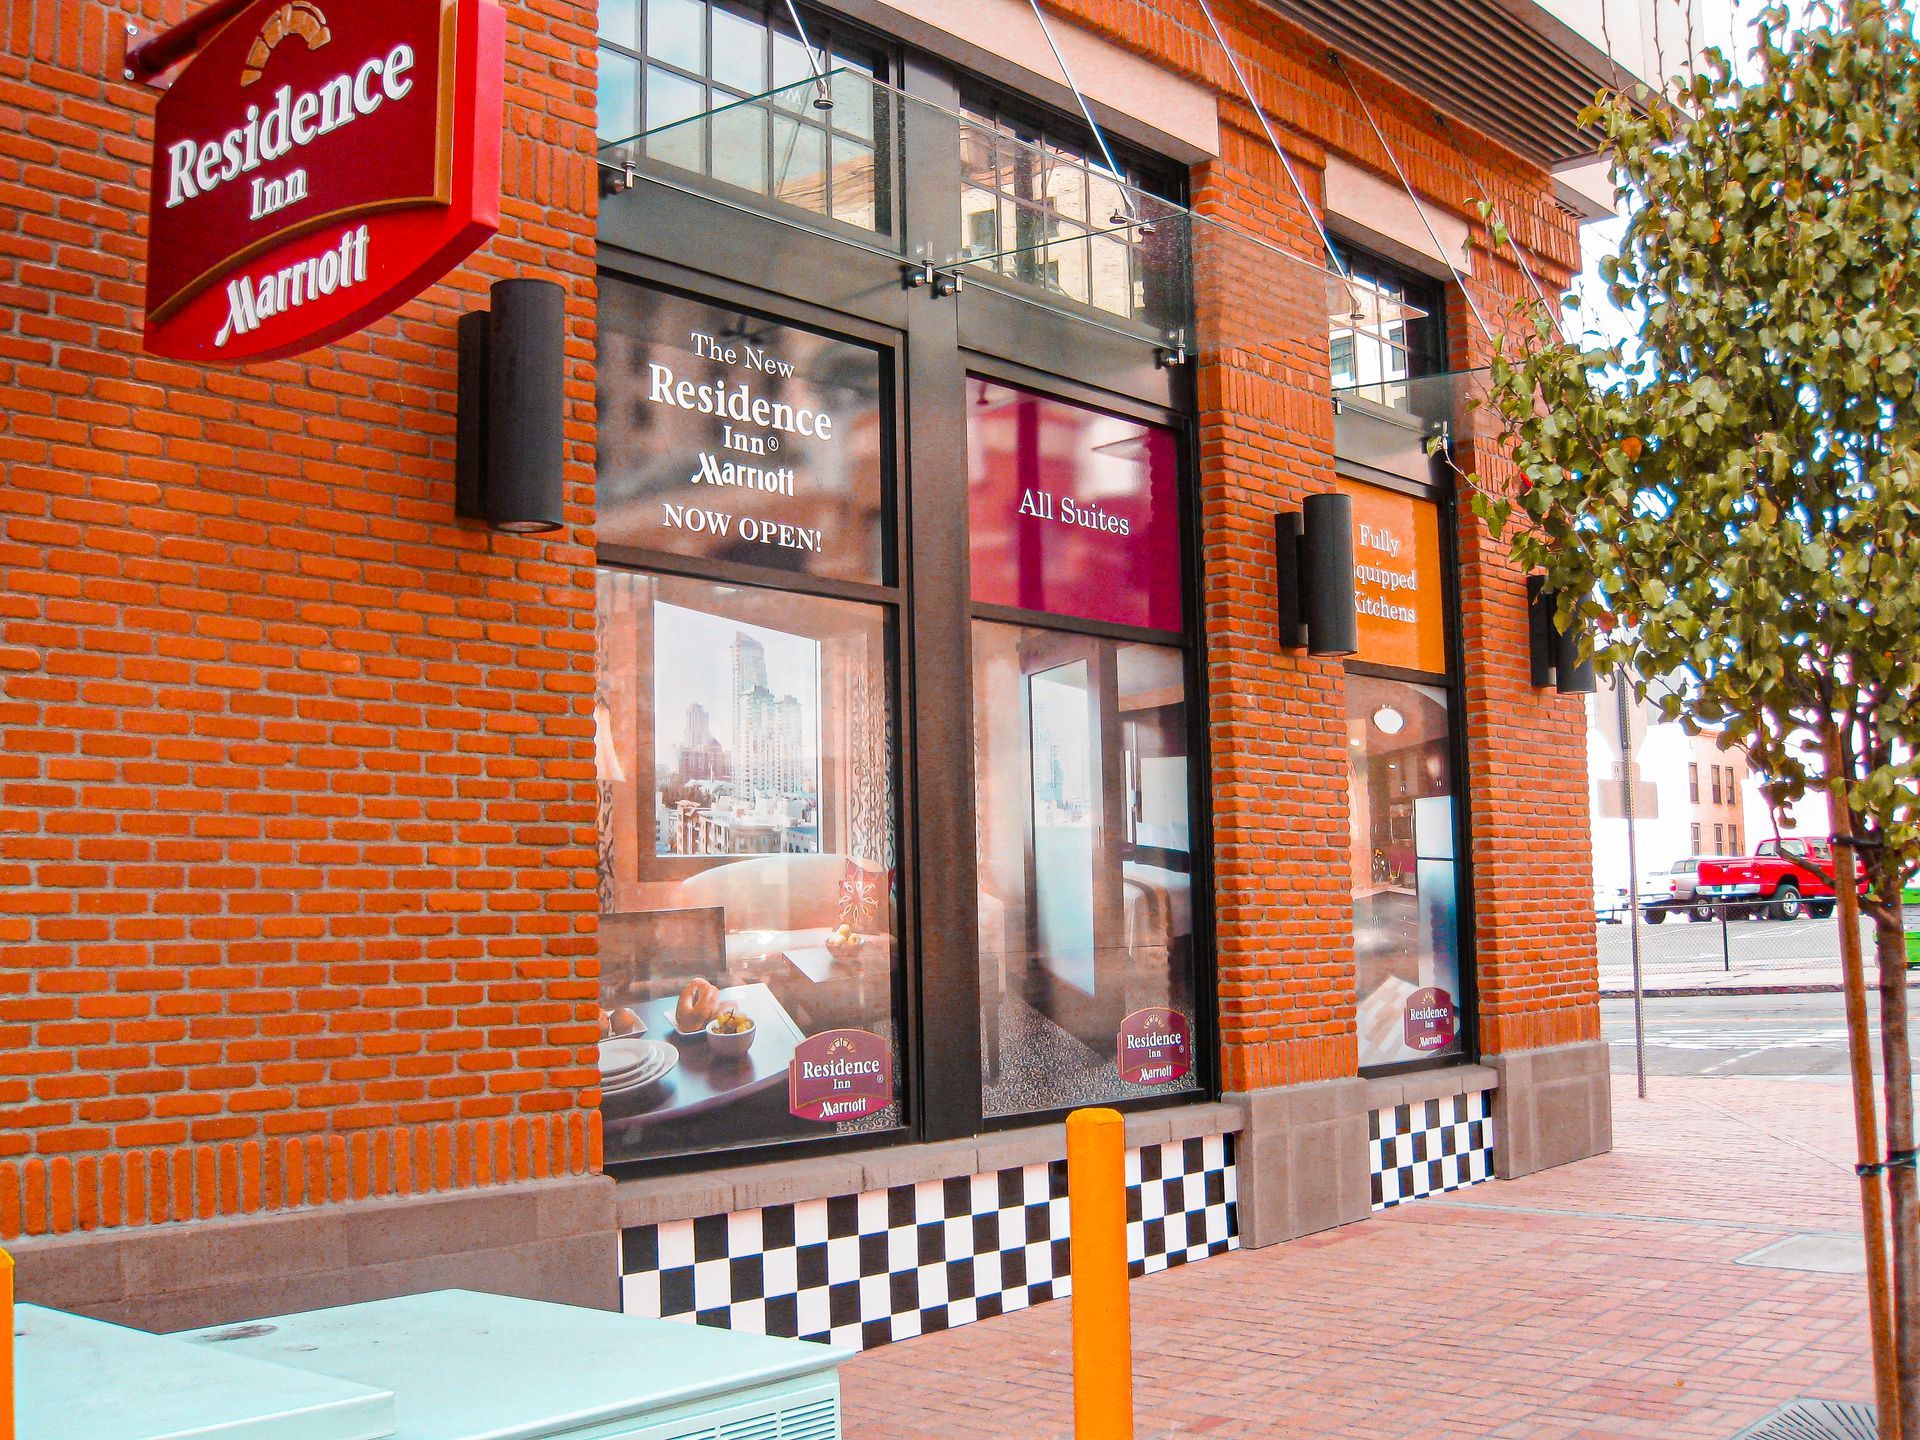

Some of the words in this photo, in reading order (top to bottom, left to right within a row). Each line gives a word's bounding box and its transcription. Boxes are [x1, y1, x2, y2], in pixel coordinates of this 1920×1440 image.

[166, 42, 416, 208] Residence
[249, 168, 308, 221] Inn
[214, 224, 371, 348] Marriott
[690, 331, 738, 366] The
[743, 345, 796, 379] New
[648, 363, 833, 441] Residence
[690, 451, 795, 497] Marriott
[662, 503, 733, 537] NOW
[738, 517, 824, 553] OPEN!
[1018, 488, 1054, 521] All
[1060, 496, 1131, 537] Suites
[1359, 523, 1401, 558] Fully
[1353, 561, 1417, 592] quipped
[1410, 1006, 1448, 1021] Residence
[1126, 1032, 1182, 1049] Residence
[1148, 1048, 1162, 1059] Inn
[803, 1058, 880, 1079] Residence
[833, 1078, 851, 1090] Inn
[1138, 1064, 1173, 1083] Marriott
[818, 1097, 868, 1119] Marriott
